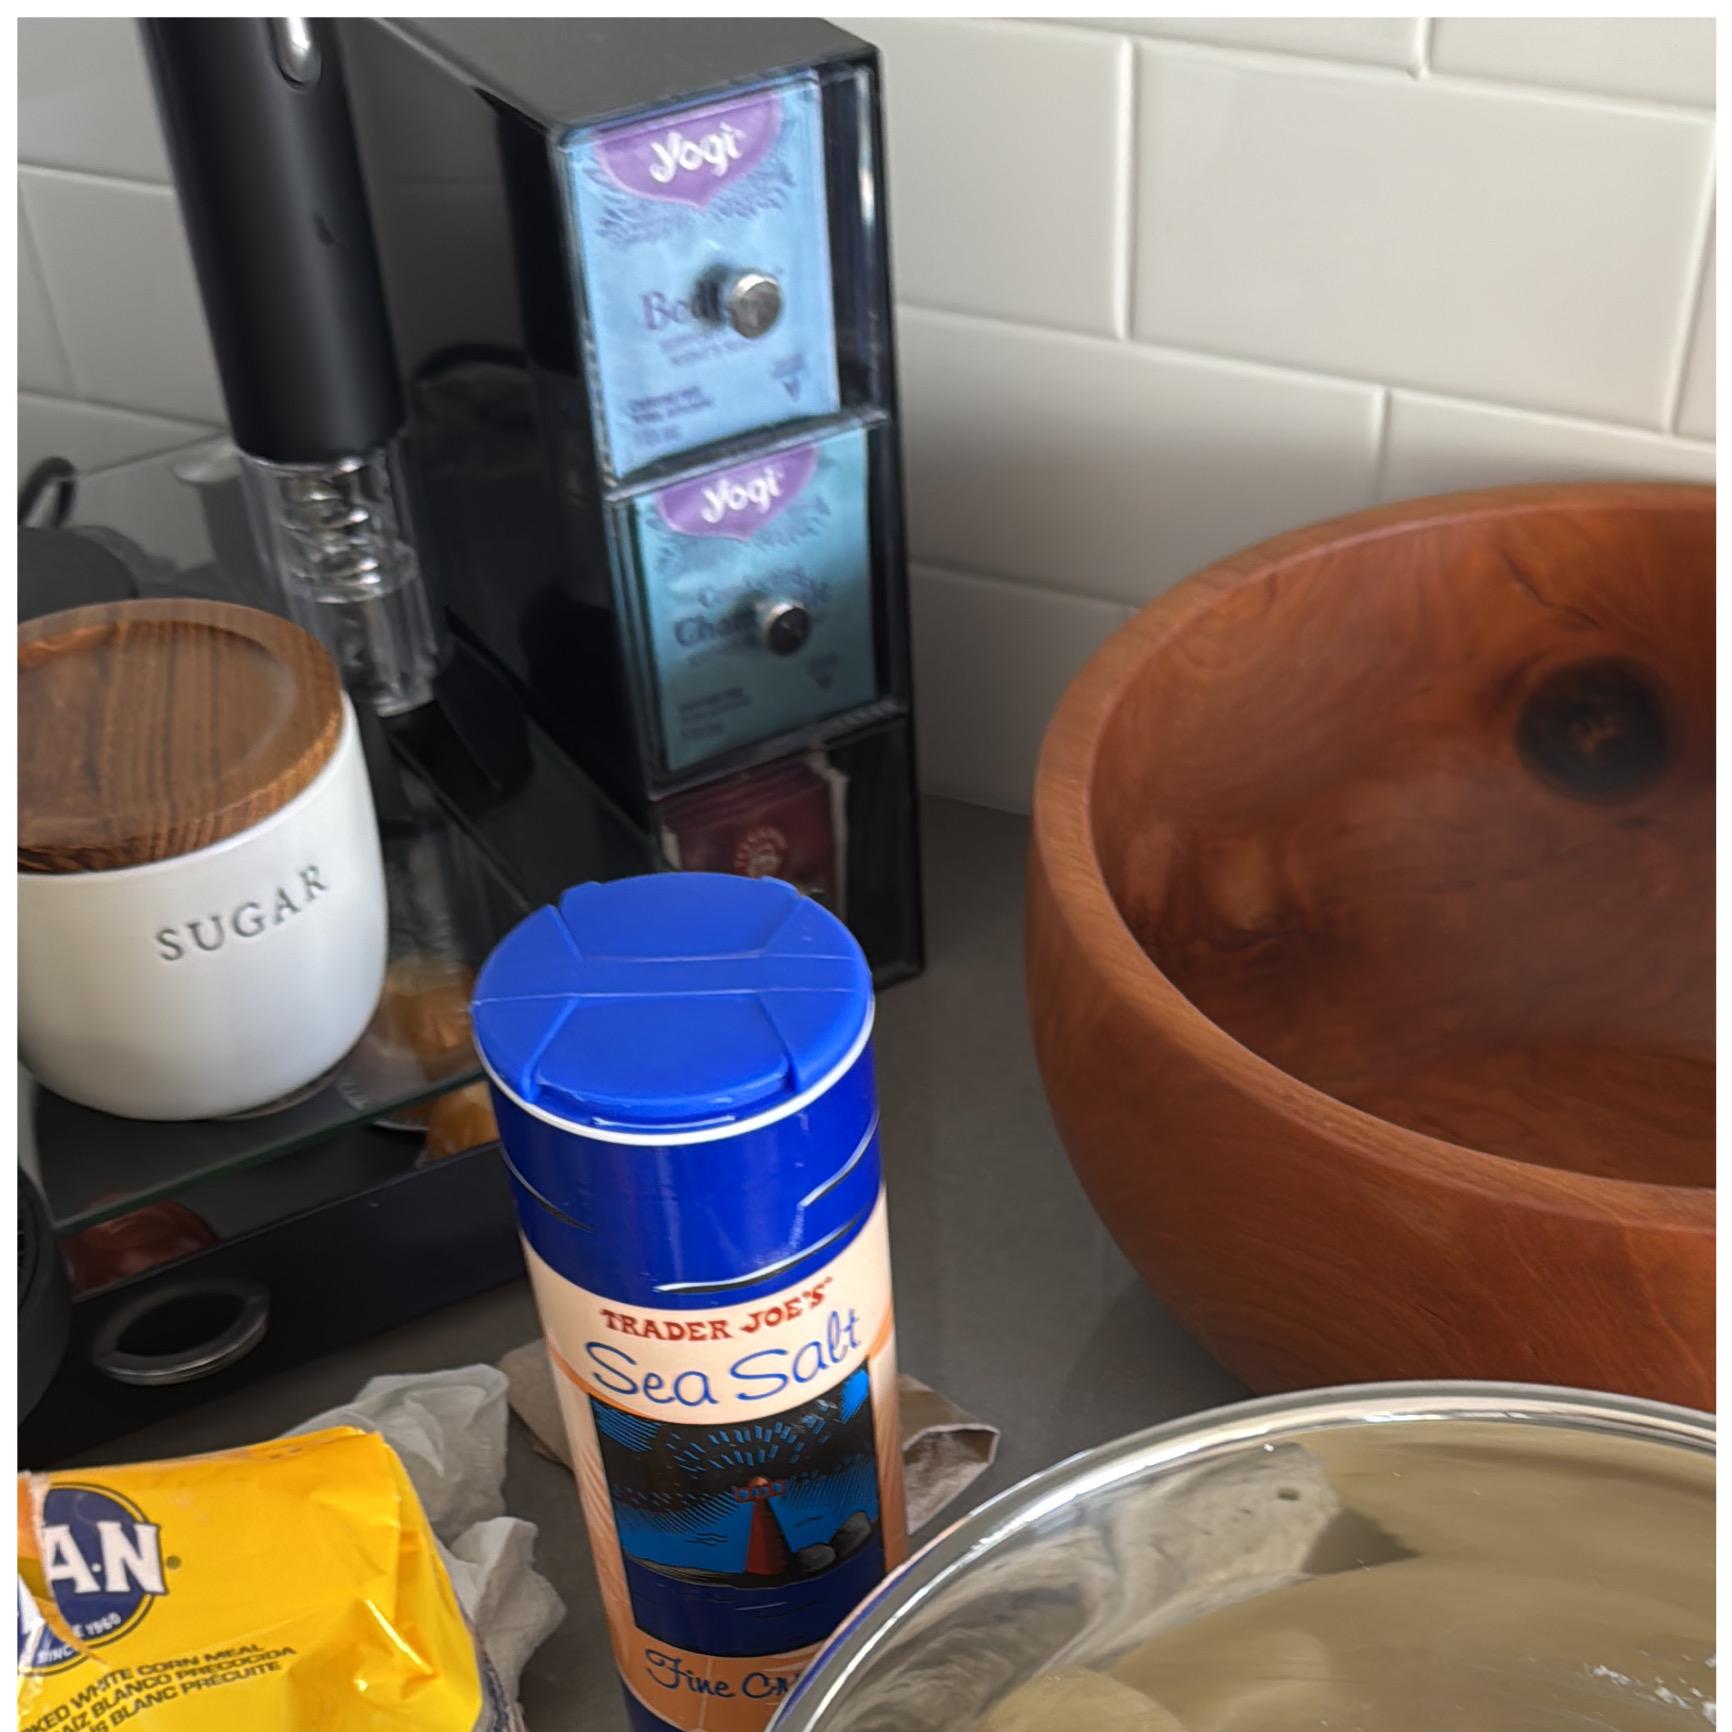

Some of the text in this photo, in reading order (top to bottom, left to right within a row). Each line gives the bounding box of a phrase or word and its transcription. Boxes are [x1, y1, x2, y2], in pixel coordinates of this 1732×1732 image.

[155, 865, 328, 962] SUGAR
[600, 1283, 827, 1341] TRADER JOE'S
[585, 1308, 863, 1407] Sea Salt
[69, 1667, 135, 1709] WHITE
[136, 1656, 200, 1676] CORN
[203, 1643, 265, 1662] MEAL
[90, 1673, 173, 1719] BLANCO
[174, 1646, 297, 1680] PRECOCIDA
[109, 1685, 179, 1727] BLANC
[644, 1648, 737, 1699] Fine
